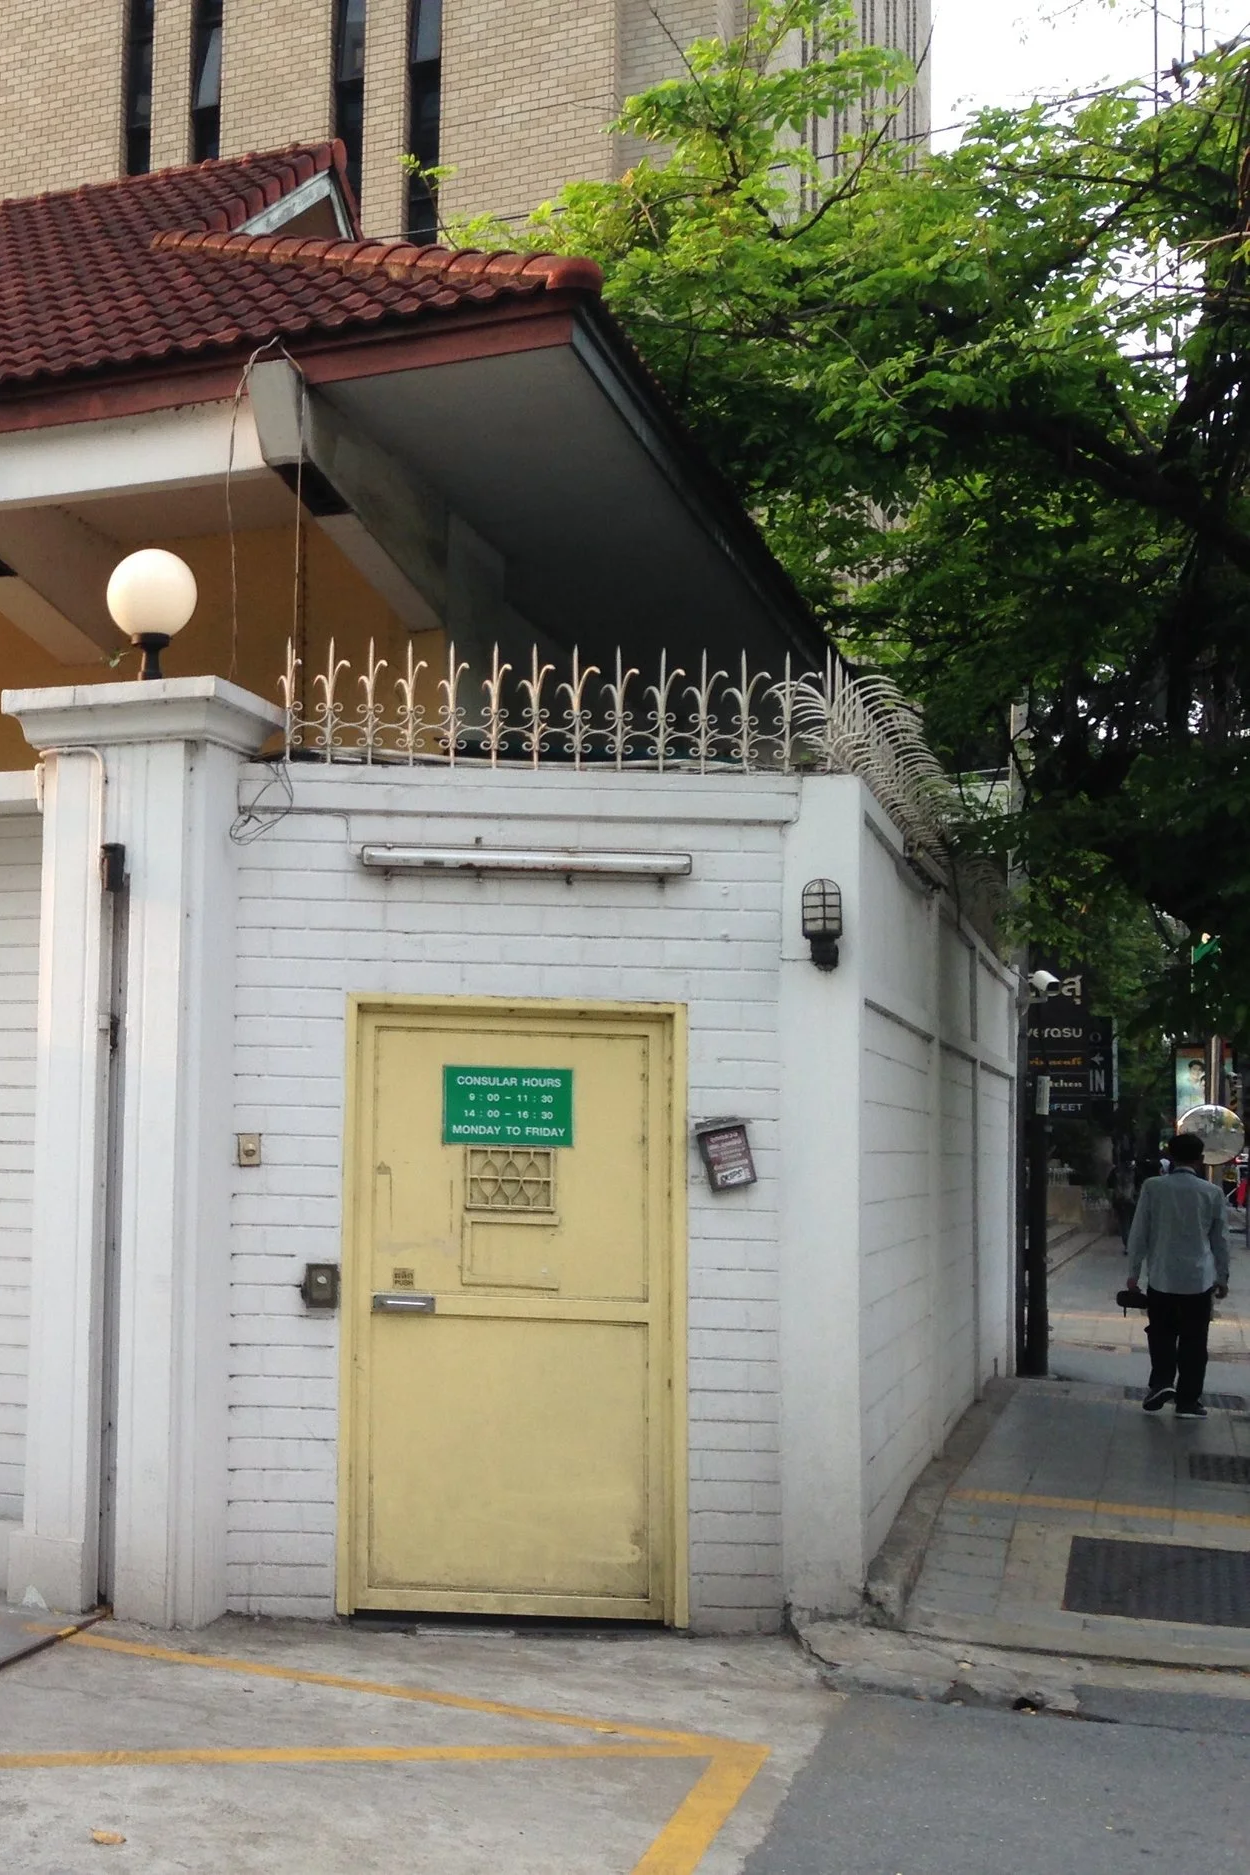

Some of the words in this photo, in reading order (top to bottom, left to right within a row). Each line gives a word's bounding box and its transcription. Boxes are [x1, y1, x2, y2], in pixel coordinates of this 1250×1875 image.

[456, 1075, 518, 1087] CONSULAR
[522, 1077, 562, 1088] HOURS
[1090, 1069, 1105, 1092] IN
[452, 1124, 501, 1135] MONDAY
[506, 1126, 521, 1136] TO
[525, 1126, 566, 1137] FRIDAY
